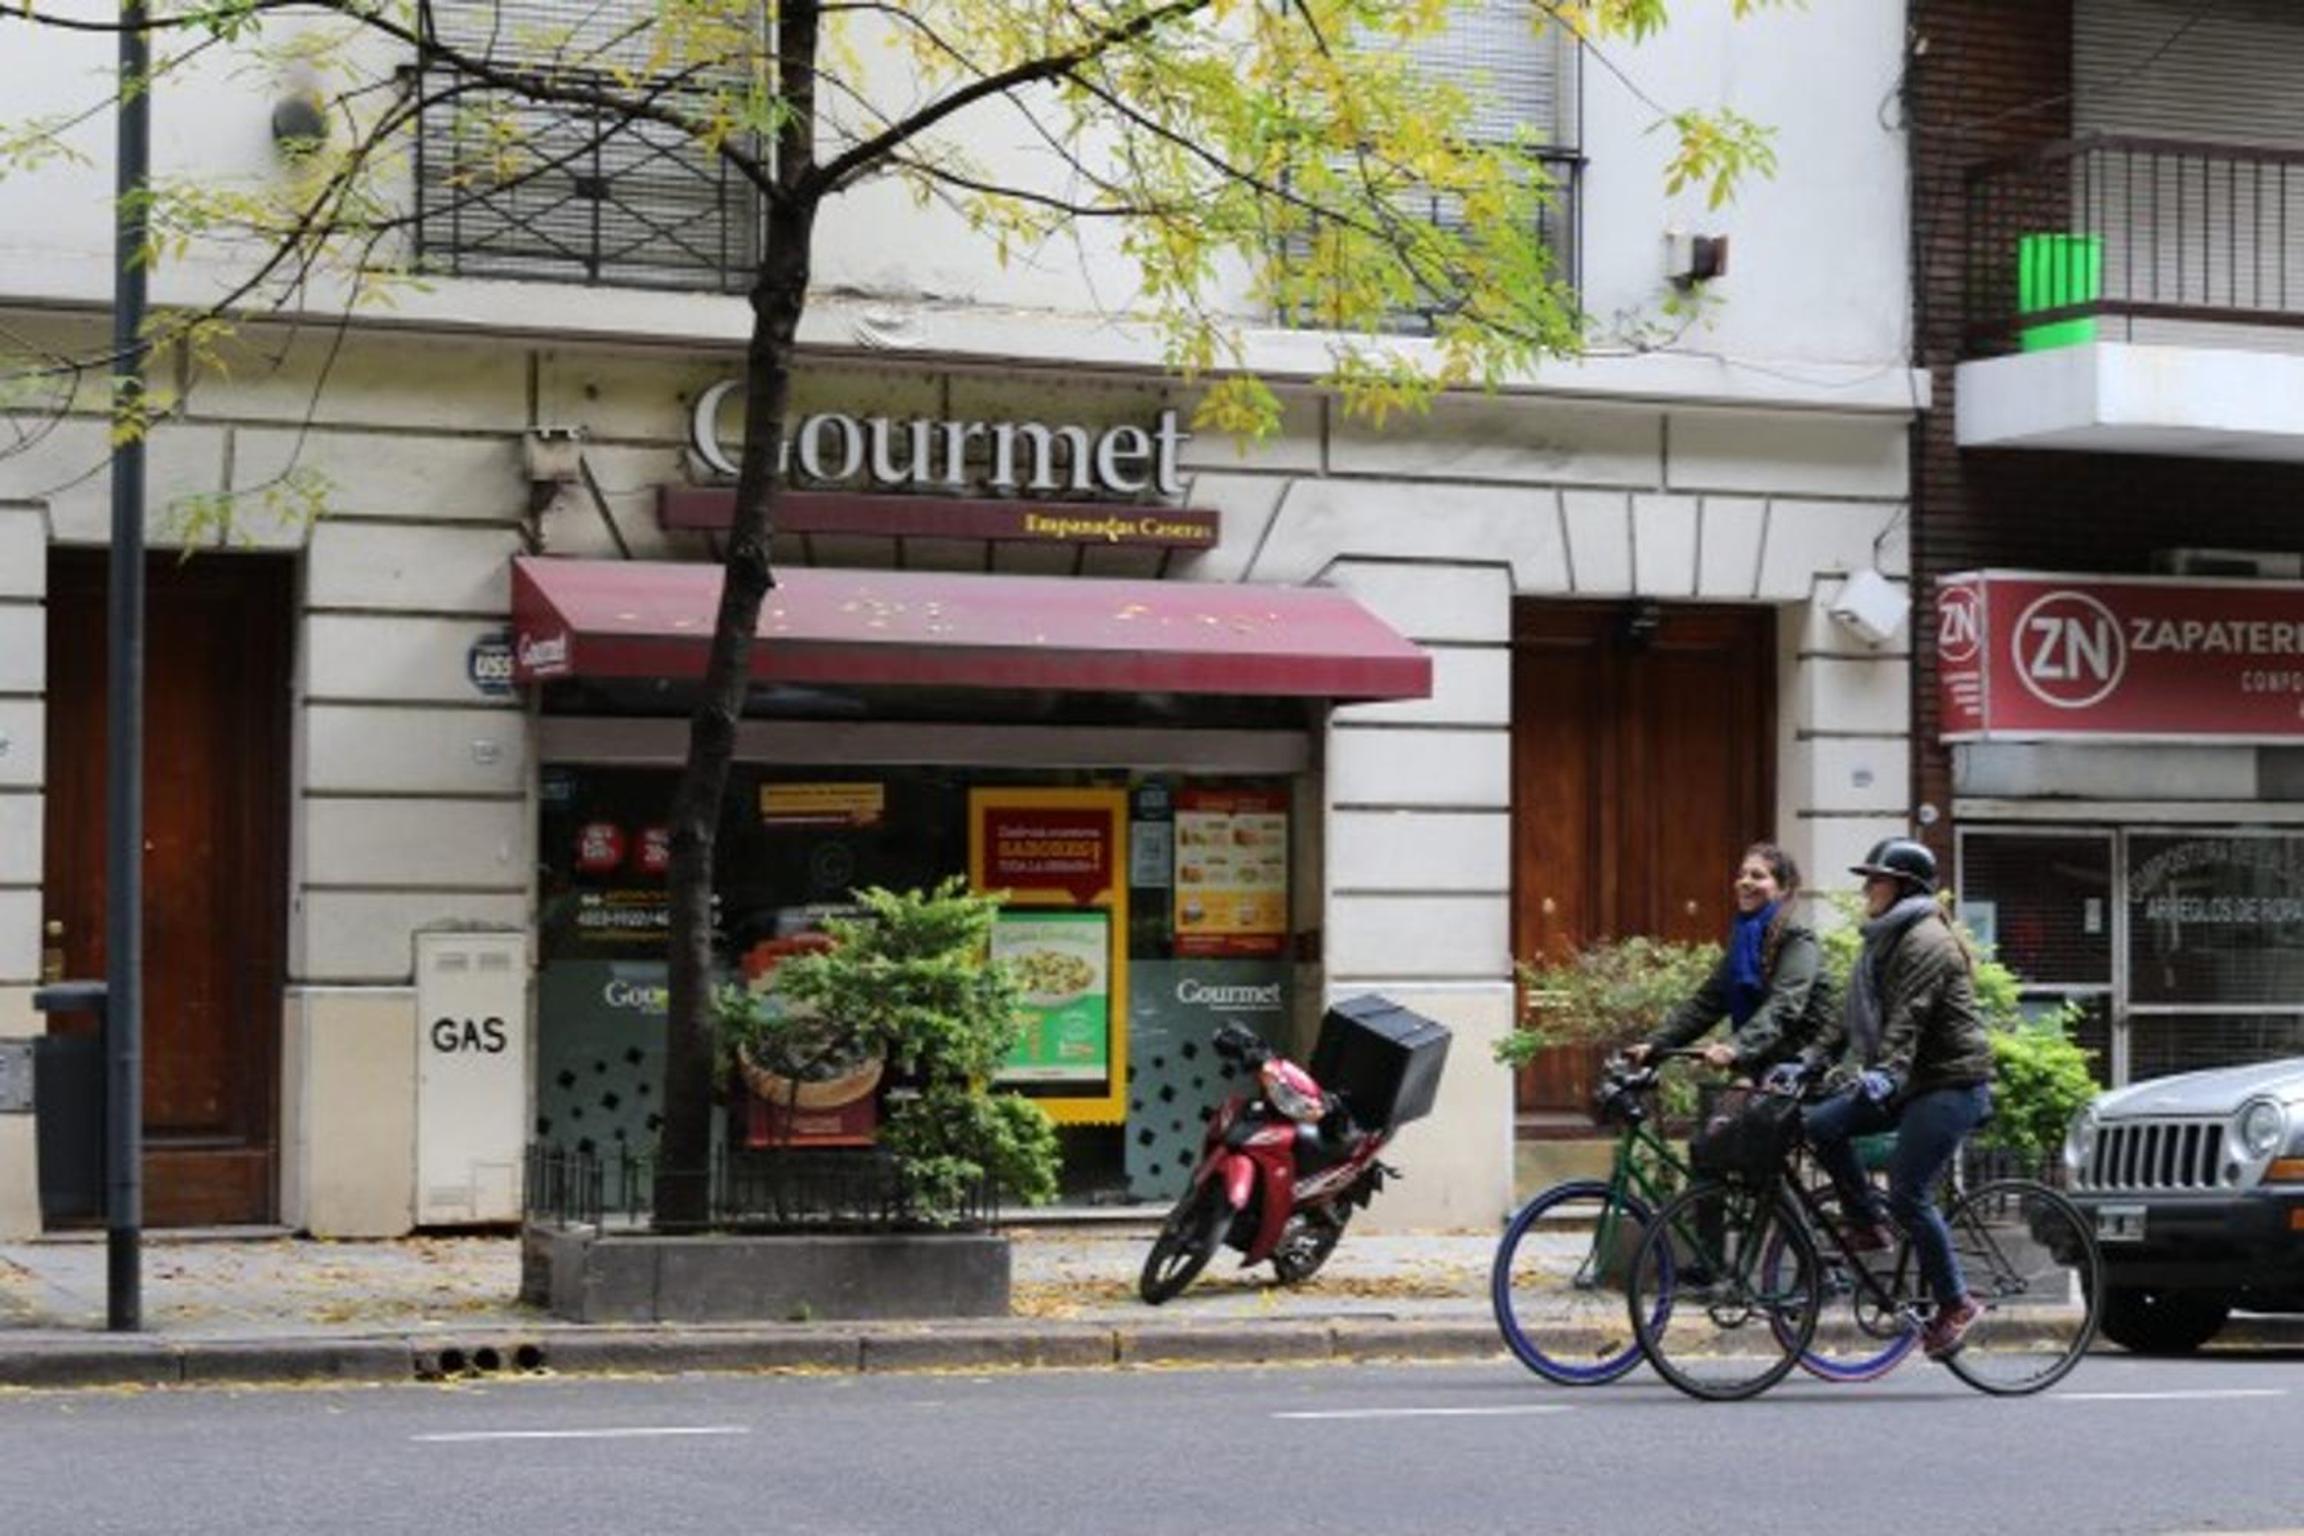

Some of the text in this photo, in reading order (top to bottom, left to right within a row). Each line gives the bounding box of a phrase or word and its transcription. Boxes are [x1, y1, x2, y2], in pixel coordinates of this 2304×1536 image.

[691, 378, 1191, 495] Gourmet
[1024, 513, 1214, 543] Empanadas Caseras
[1937, 601, 1977, 646] ZN
[2030, 617, 2110, 681] ZN
[1177, 978, 1281, 1004] Gourmet
[430, 1016, 507, 1053] GAS
